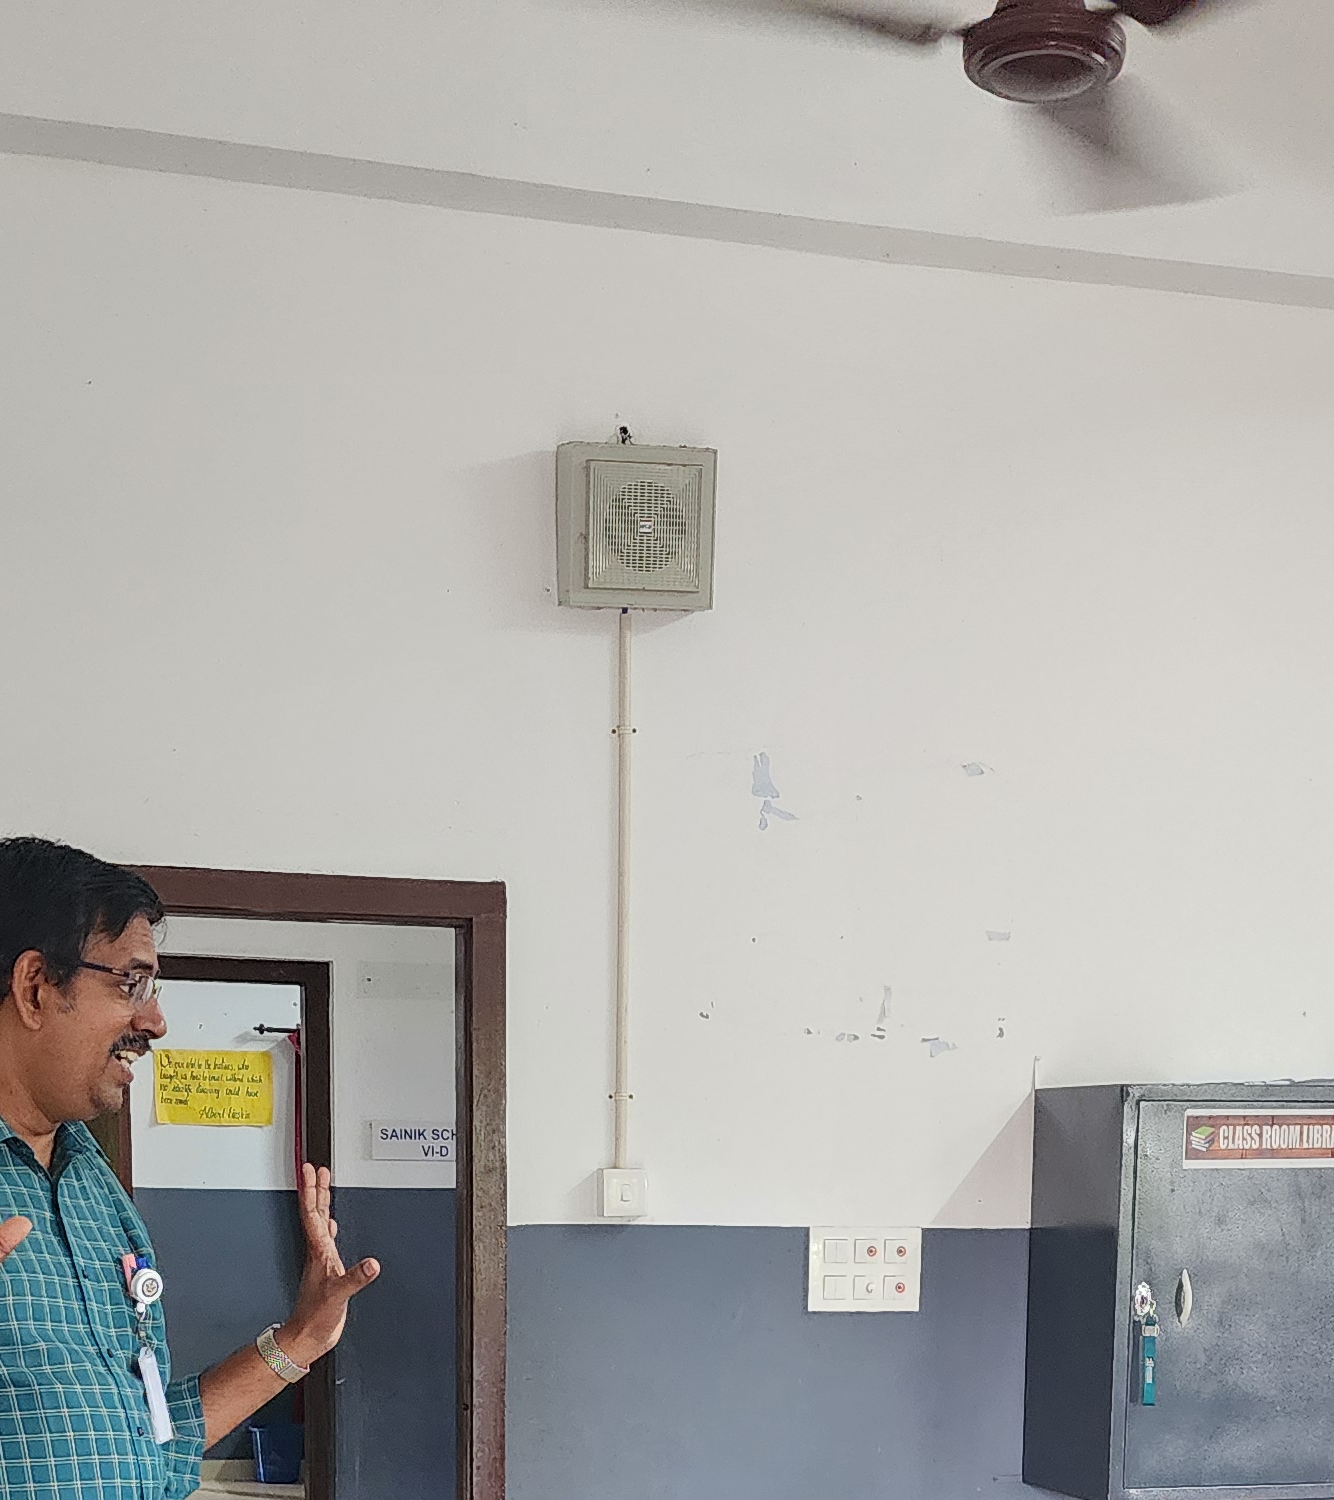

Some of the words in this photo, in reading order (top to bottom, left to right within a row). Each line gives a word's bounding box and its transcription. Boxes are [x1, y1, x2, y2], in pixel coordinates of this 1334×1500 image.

[380, 1128, 427, 1140] SAINIK
[1219, 1125, 1260, 1149] CLASS
[1262, 1125, 1300, 1149] ROOM
[422, 1145, 449, 1157] VI-D
